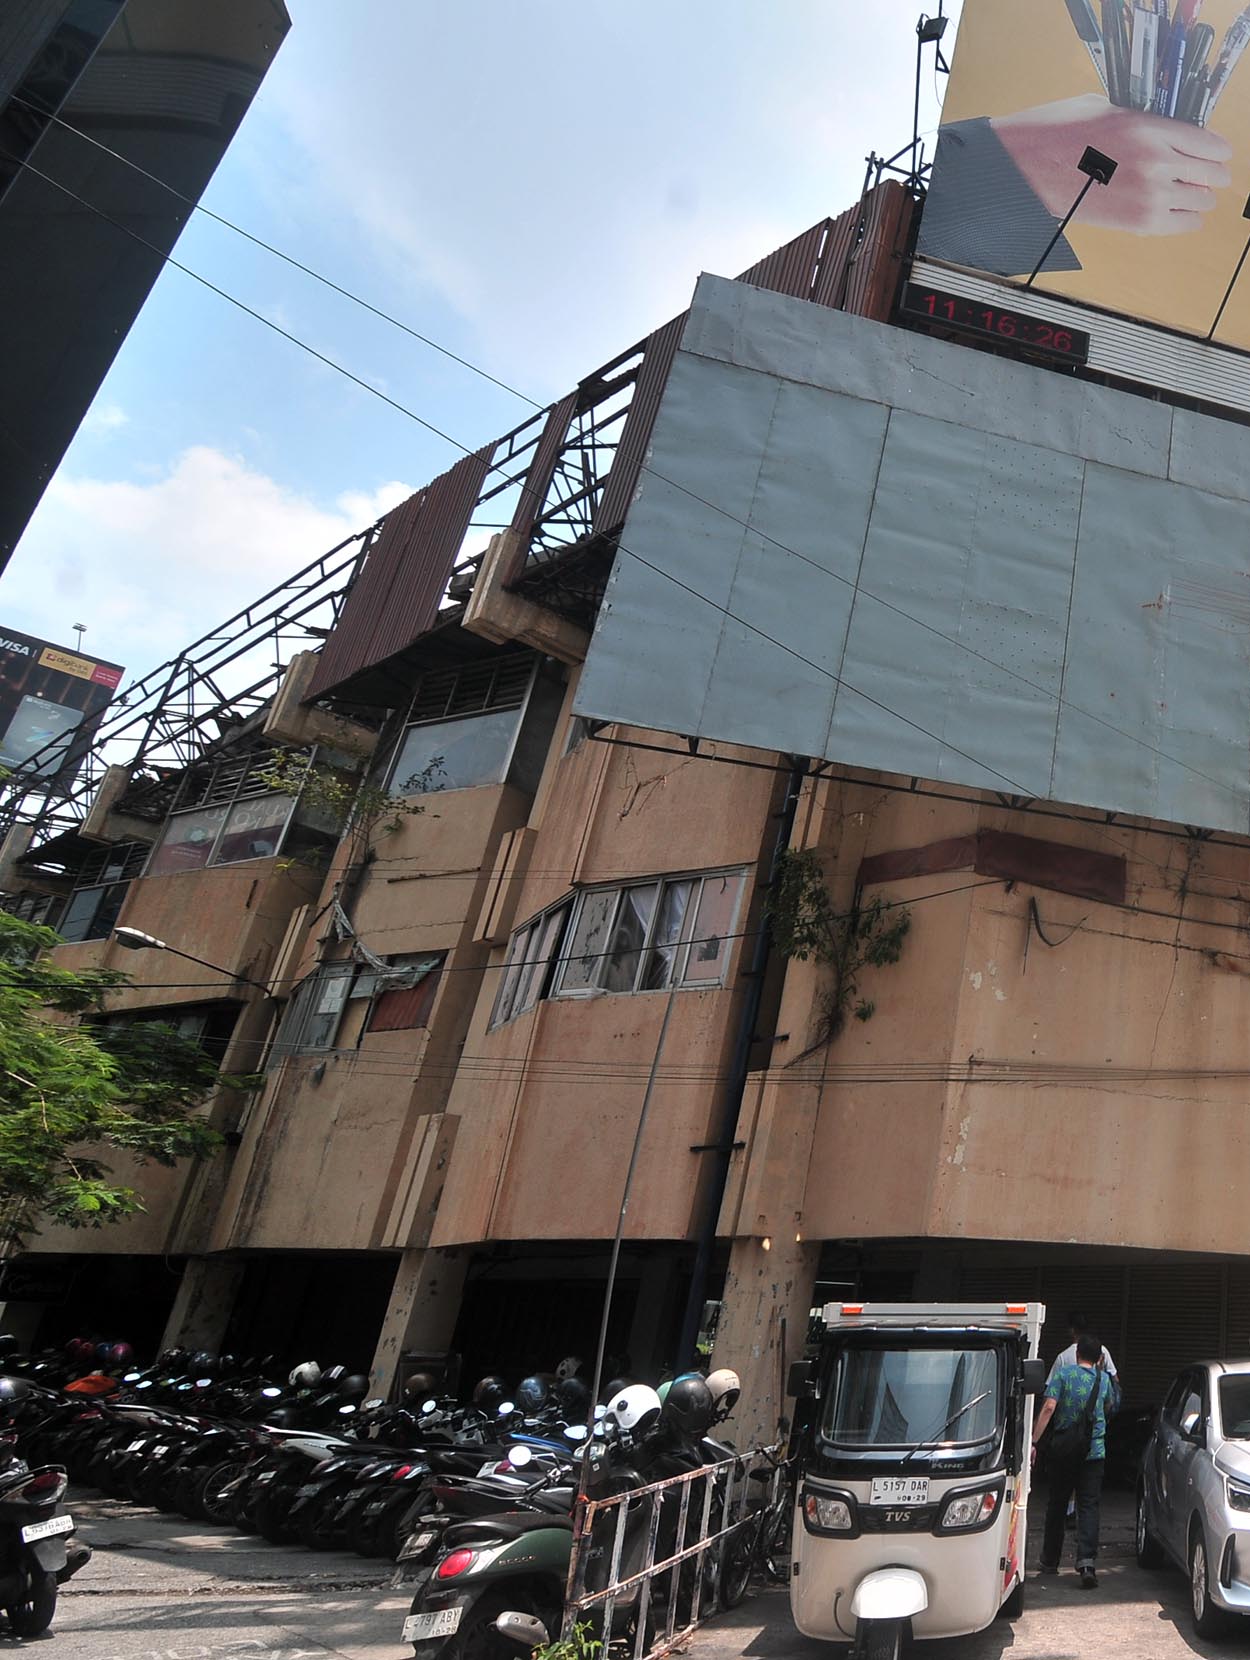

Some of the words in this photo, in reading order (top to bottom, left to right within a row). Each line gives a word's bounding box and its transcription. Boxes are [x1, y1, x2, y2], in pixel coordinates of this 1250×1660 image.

[922, 294, 1073, 353] 11:16:26
[882, 1480, 907, 1491] 5157
[885, 1511, 912, 1522] TVS
[439, 1610, 461, 1624] ABY
